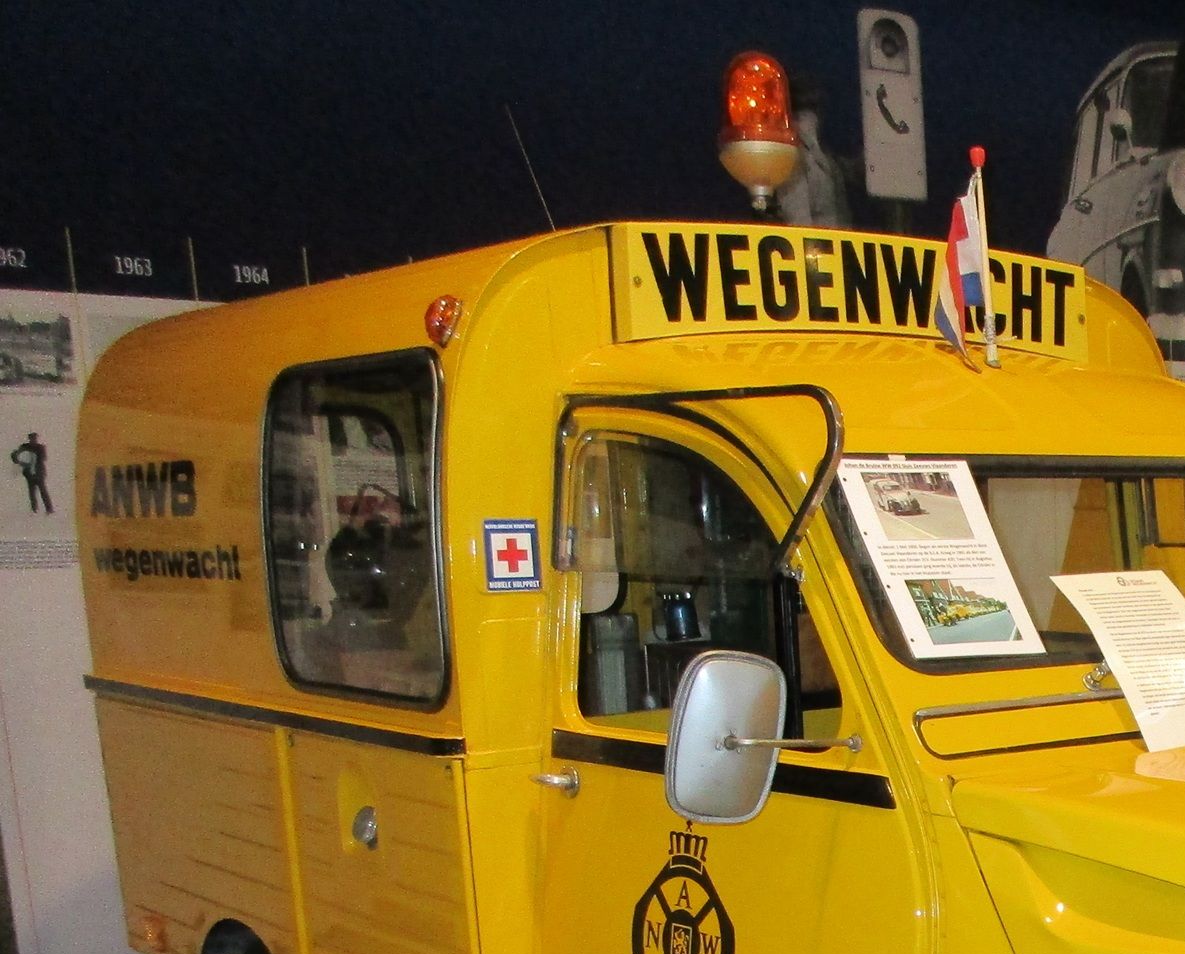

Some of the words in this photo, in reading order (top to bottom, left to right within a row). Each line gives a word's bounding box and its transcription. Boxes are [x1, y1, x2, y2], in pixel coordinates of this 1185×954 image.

[113, 255, 153, 278] 1963
[233, 264, 270, 285] 1964
[642, 232, 1075, 347] WEGENWCHT
[91, 460, 197, 517] ANWB
[94, 544, 241, 581] wegenwacht
